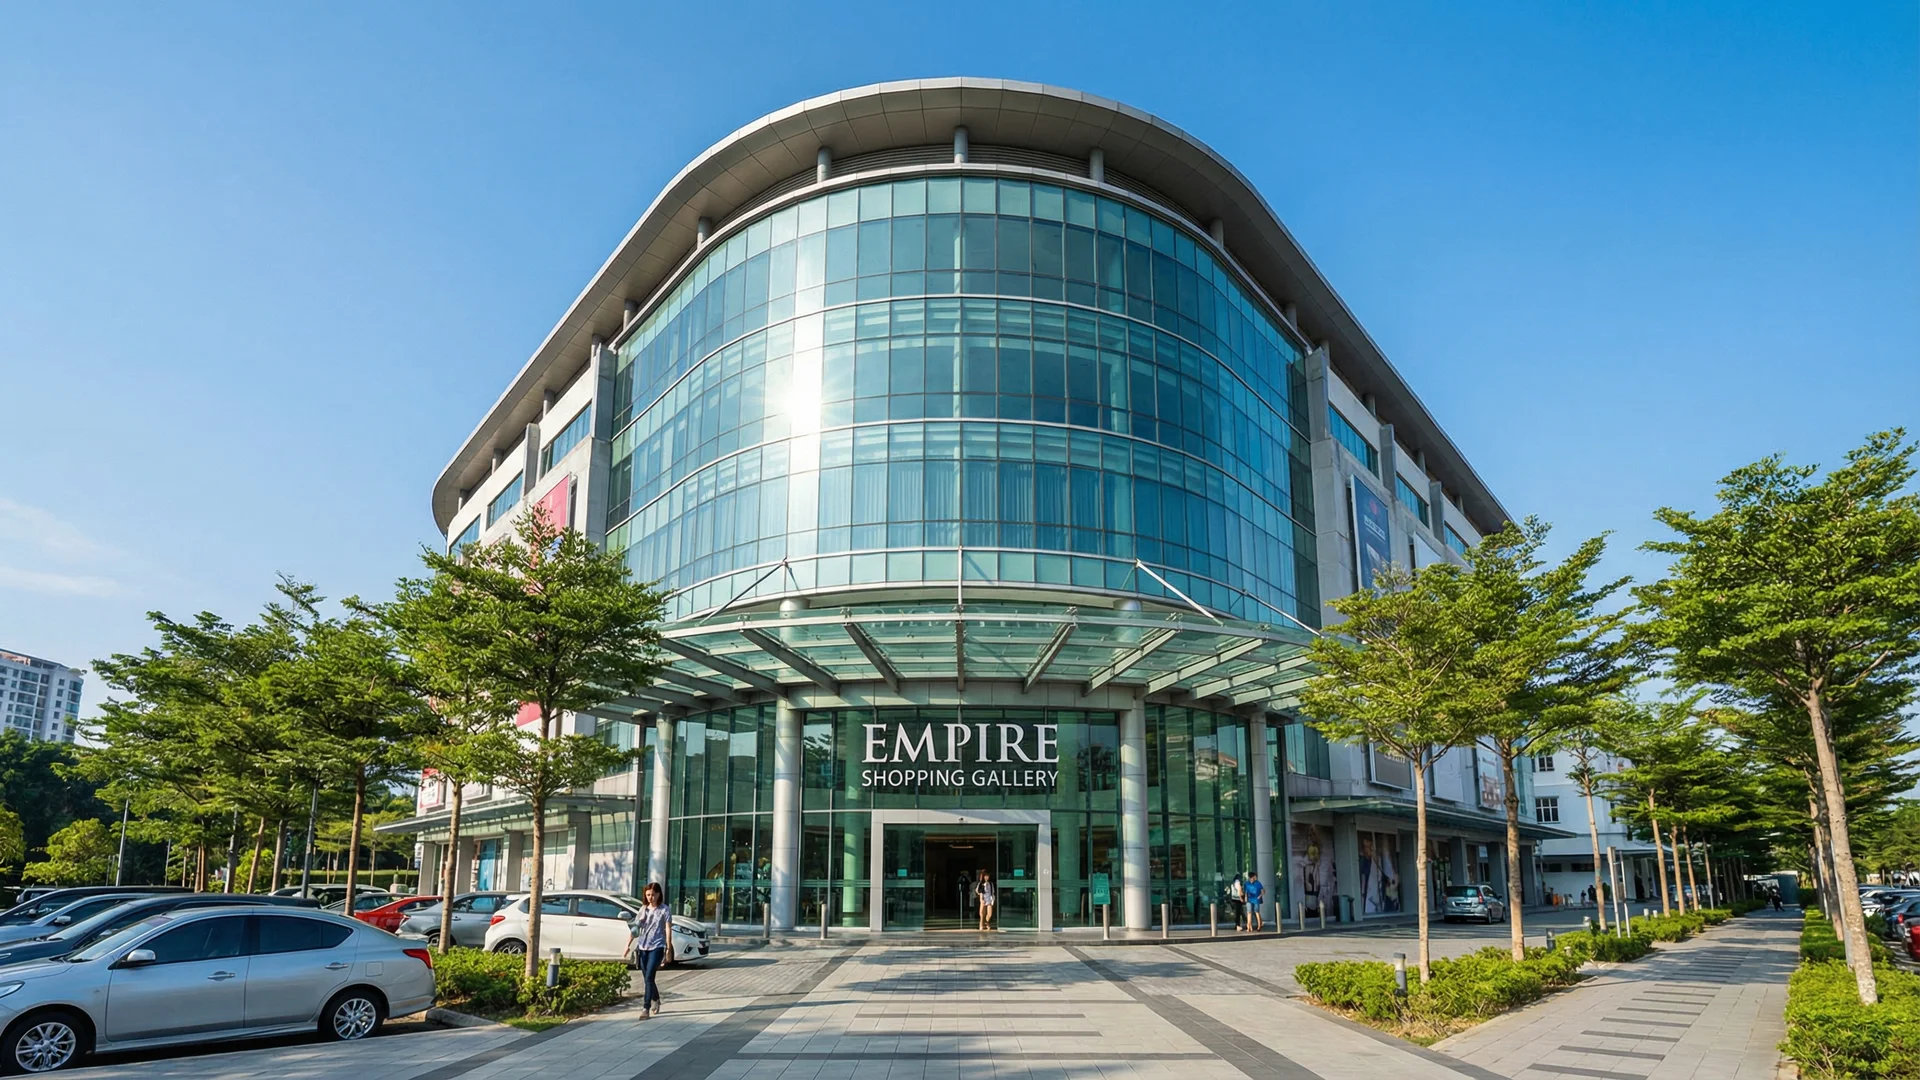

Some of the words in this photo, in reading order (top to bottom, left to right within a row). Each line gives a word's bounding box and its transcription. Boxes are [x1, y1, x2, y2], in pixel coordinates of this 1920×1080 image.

[862, 722, 1060, 763] EMPIRE
[862, 769, 965, 787] SHOPPING
[971, 769, 1060, 787] GALLERY
